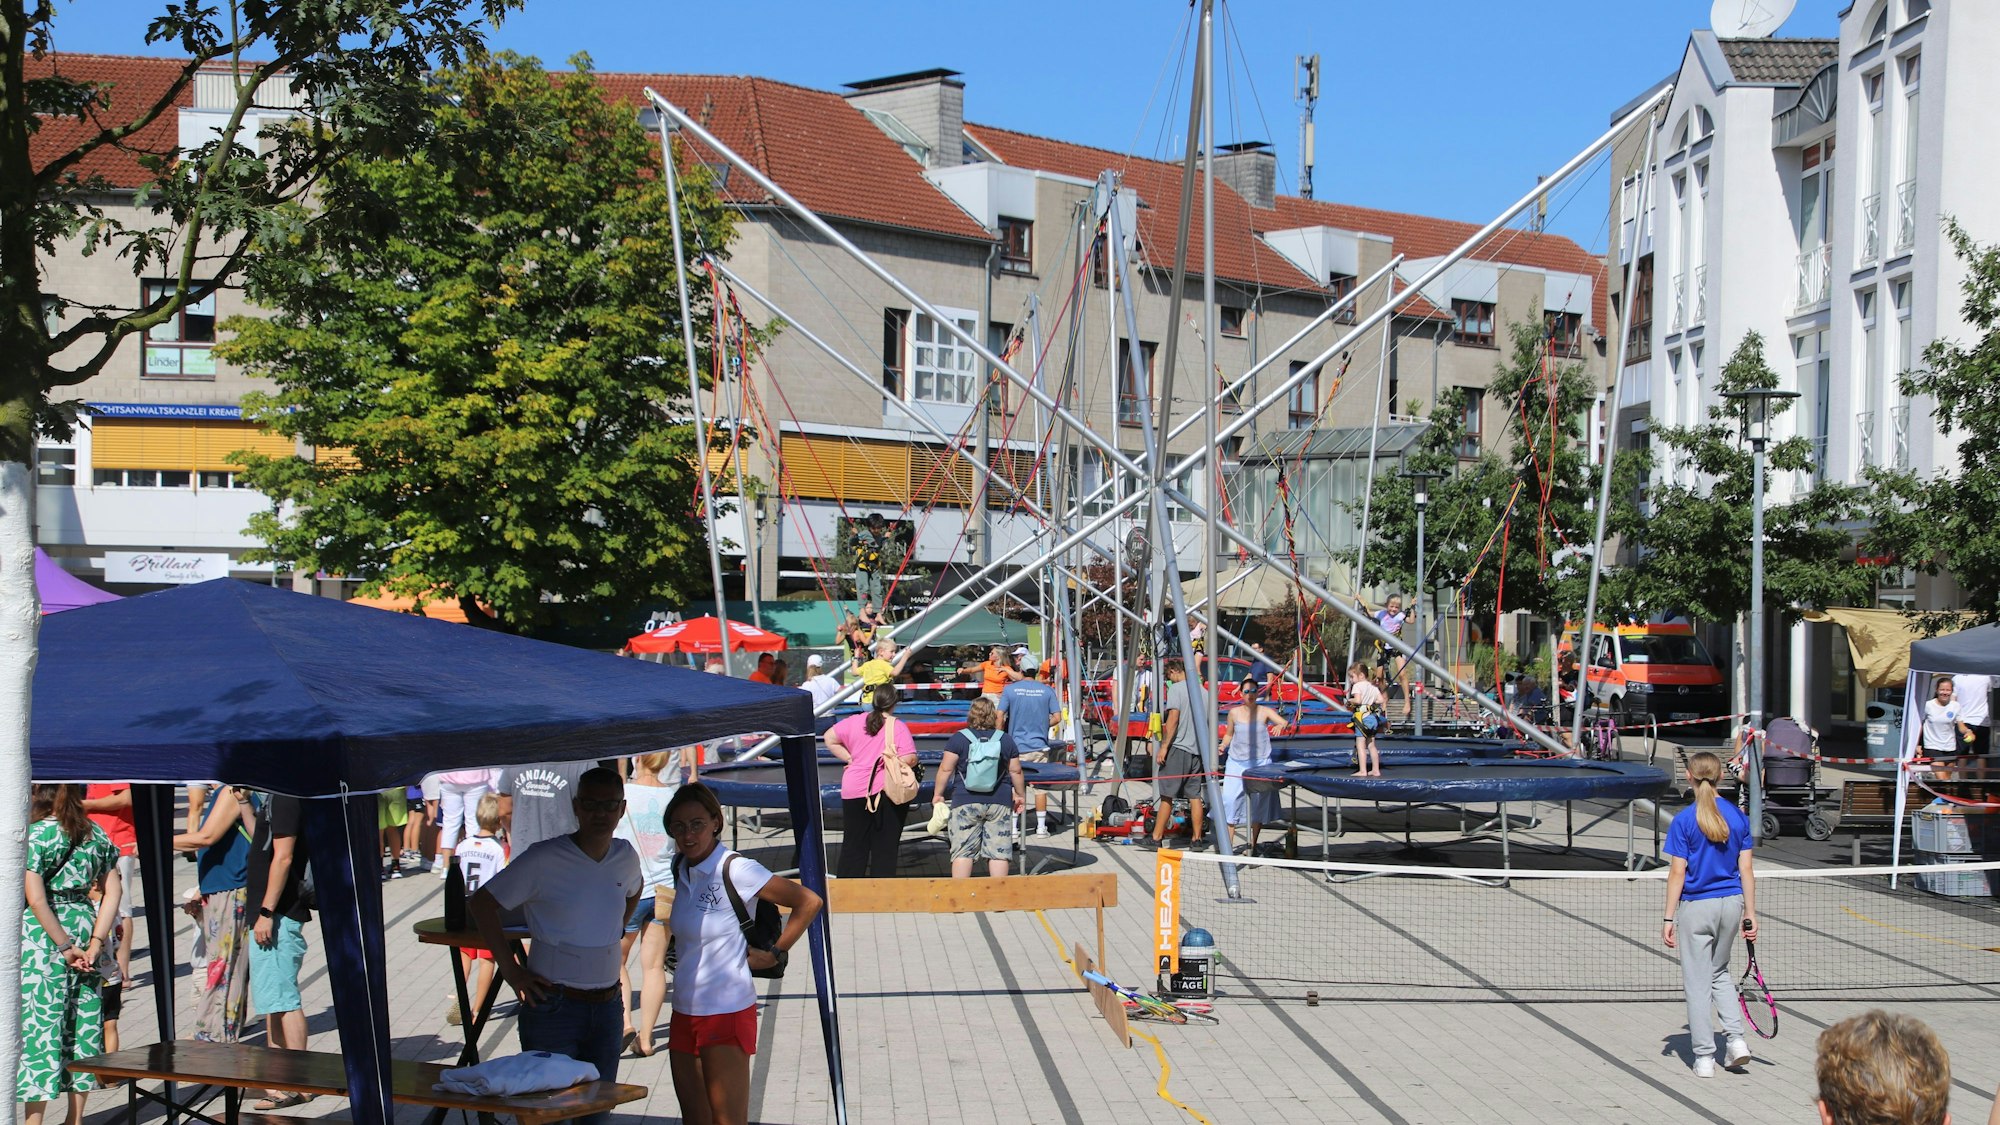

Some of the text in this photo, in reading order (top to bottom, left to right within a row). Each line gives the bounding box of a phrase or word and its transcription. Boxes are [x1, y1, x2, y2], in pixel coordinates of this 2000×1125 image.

[148, 356, 179, 367] Linder
[129, 554, 205, 572] Brillant
[514, 769, 568, 790] KANDAHAR
[1160, 863, 1173, 950] HEAD
[1172, 980, 1203, 989] STAGE
